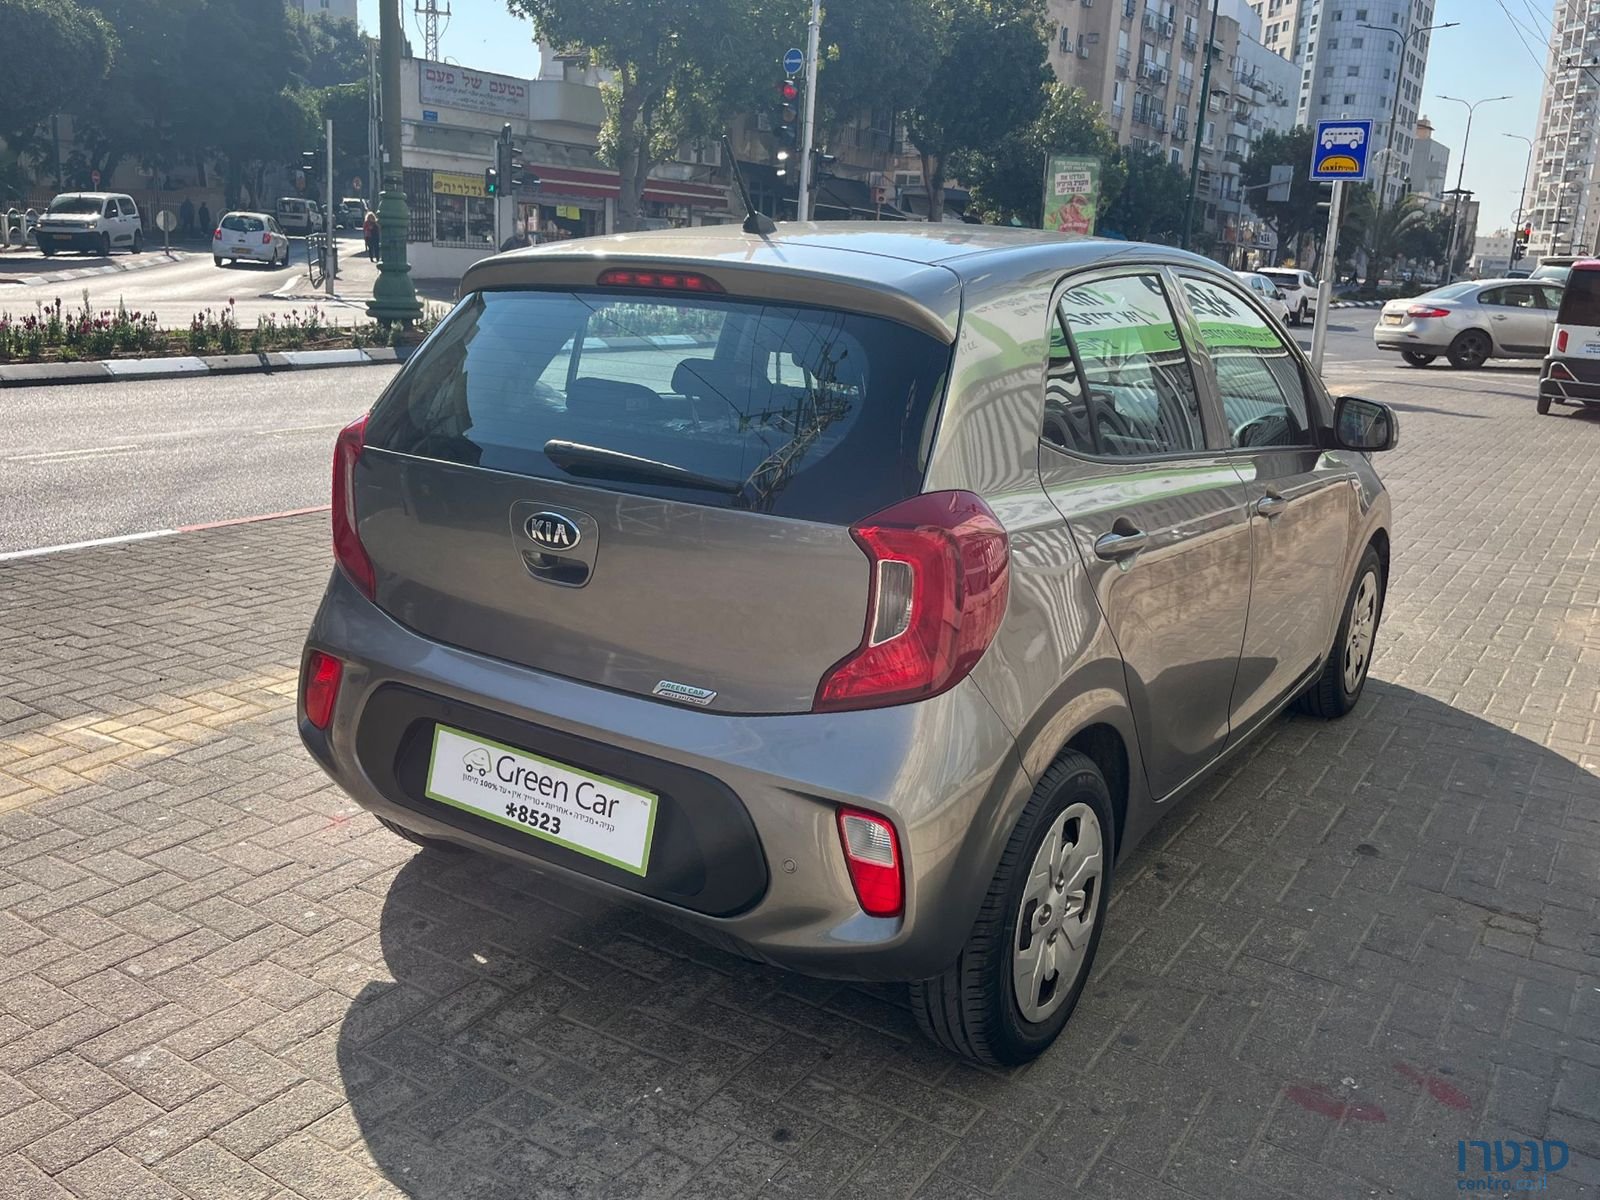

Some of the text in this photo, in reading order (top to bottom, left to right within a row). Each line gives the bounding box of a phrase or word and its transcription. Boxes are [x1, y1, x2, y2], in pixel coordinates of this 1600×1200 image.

[426, 69, 455, 84] פעם
[461, 71, 483, 89] של
[489, 80, 524, 97] בטעם
[443, 183, 484, 196] נדלריה
[531, 518, 570, 545] KIA
[660, 682, 705, 696] GREEN CAR
[462, 773, 479, 784] מימון
[480, 779, 498, 791] 100%
[496, 755, 620, 818] Green Car
[498, 785, 507, 794] עד
[511, 790, 522, 798] אין
[544, 801, 569, 815] אחריות
[599, 820, 615, 832] קניה
